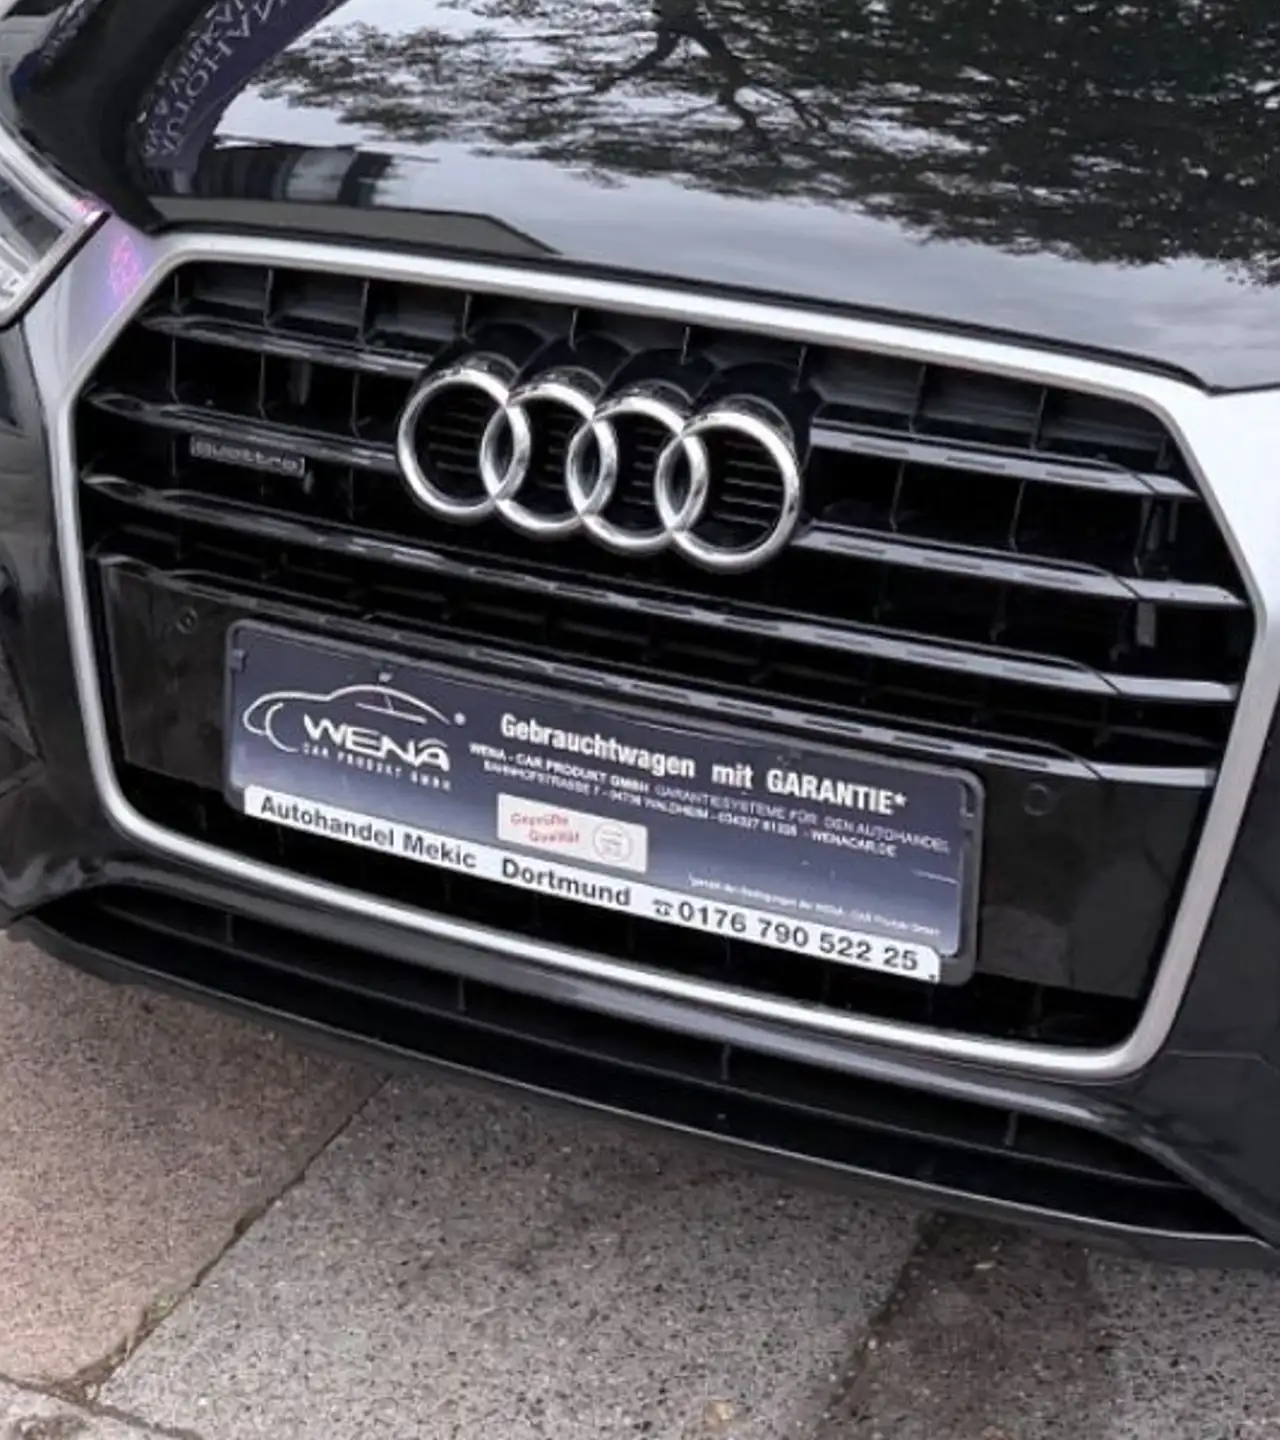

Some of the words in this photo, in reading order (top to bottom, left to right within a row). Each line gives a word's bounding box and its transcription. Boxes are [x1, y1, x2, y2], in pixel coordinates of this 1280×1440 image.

[303, 712, 450, 772] WENA
[501, 712, 695, 778] Gebrauchtwagen
[711, 762, 753, 789] mit
[261, 795, 394, 847] Autohandel
[403, 832, 477, 868] Mekic
[502, 857, 631, 906] Dortmund
[679, 900, 747, 933] 0176
[757, 917, 809, 948] 790
[819, 933, 873, 961] 522
[883, 947, 919, 971] 25
